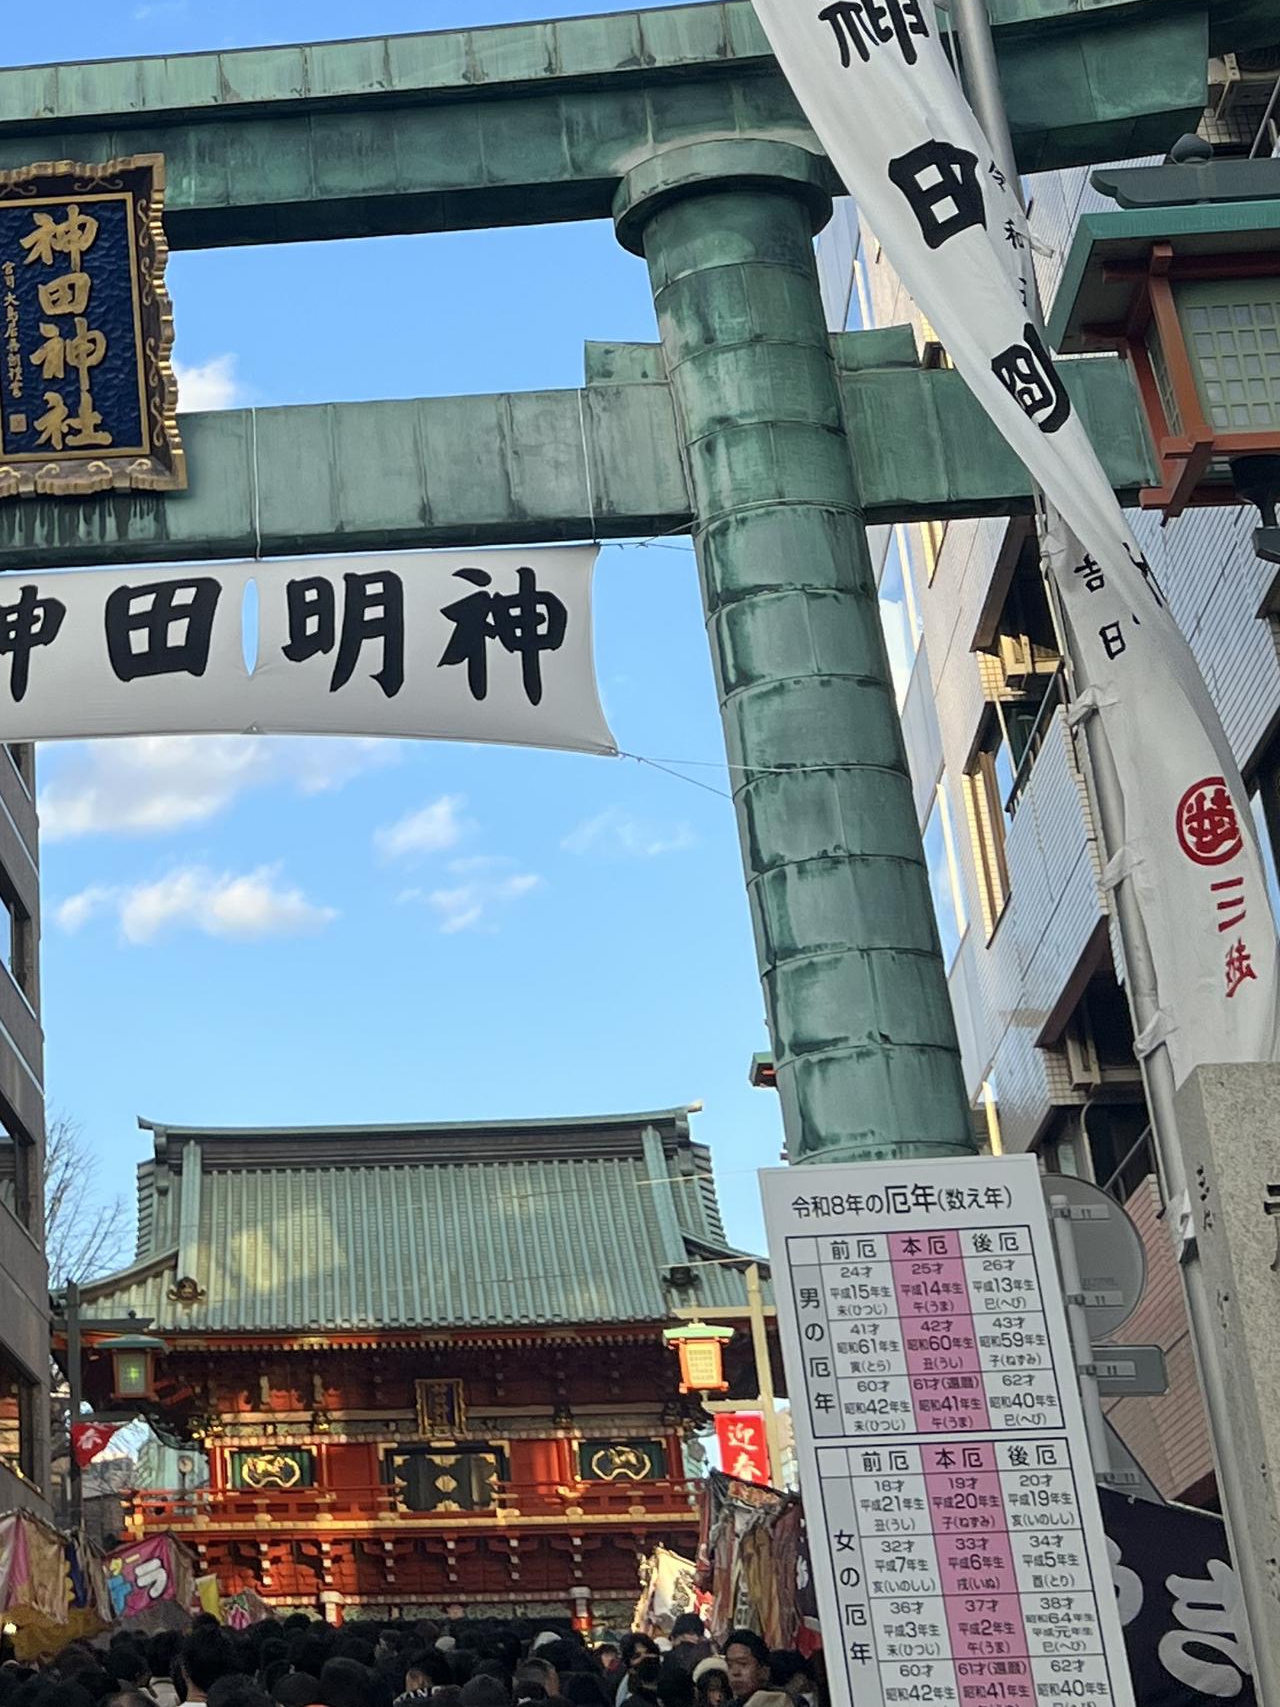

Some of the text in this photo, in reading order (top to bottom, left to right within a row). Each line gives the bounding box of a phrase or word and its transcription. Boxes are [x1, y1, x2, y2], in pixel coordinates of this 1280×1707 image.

[20, 204, 113, 451] 神田神社
[830, 1234, 1019, 1260] 前厄 本厄 後厄
[840, 1260, 1015, 1278] 24才 25才 26才
[850, 1317, 1024, 1335] 41才 42才 43才
[857, 1380, 889, 1392] 60才
[1002, 1374, 1034, 1387] 62才
[862, 1445, 1057, 1472] 前厄 本厄 後厄
[874, 1474, 1052, 1492] 18才 19才 20才
[881, 1534, 1063, 1552] 32才 33才 34才
[890, 1597, 1074, 1614] 36才 37才 38才
[900, 1665, 933, 1677] 60才
[1051, 1659, 1084, 1672] 62才
